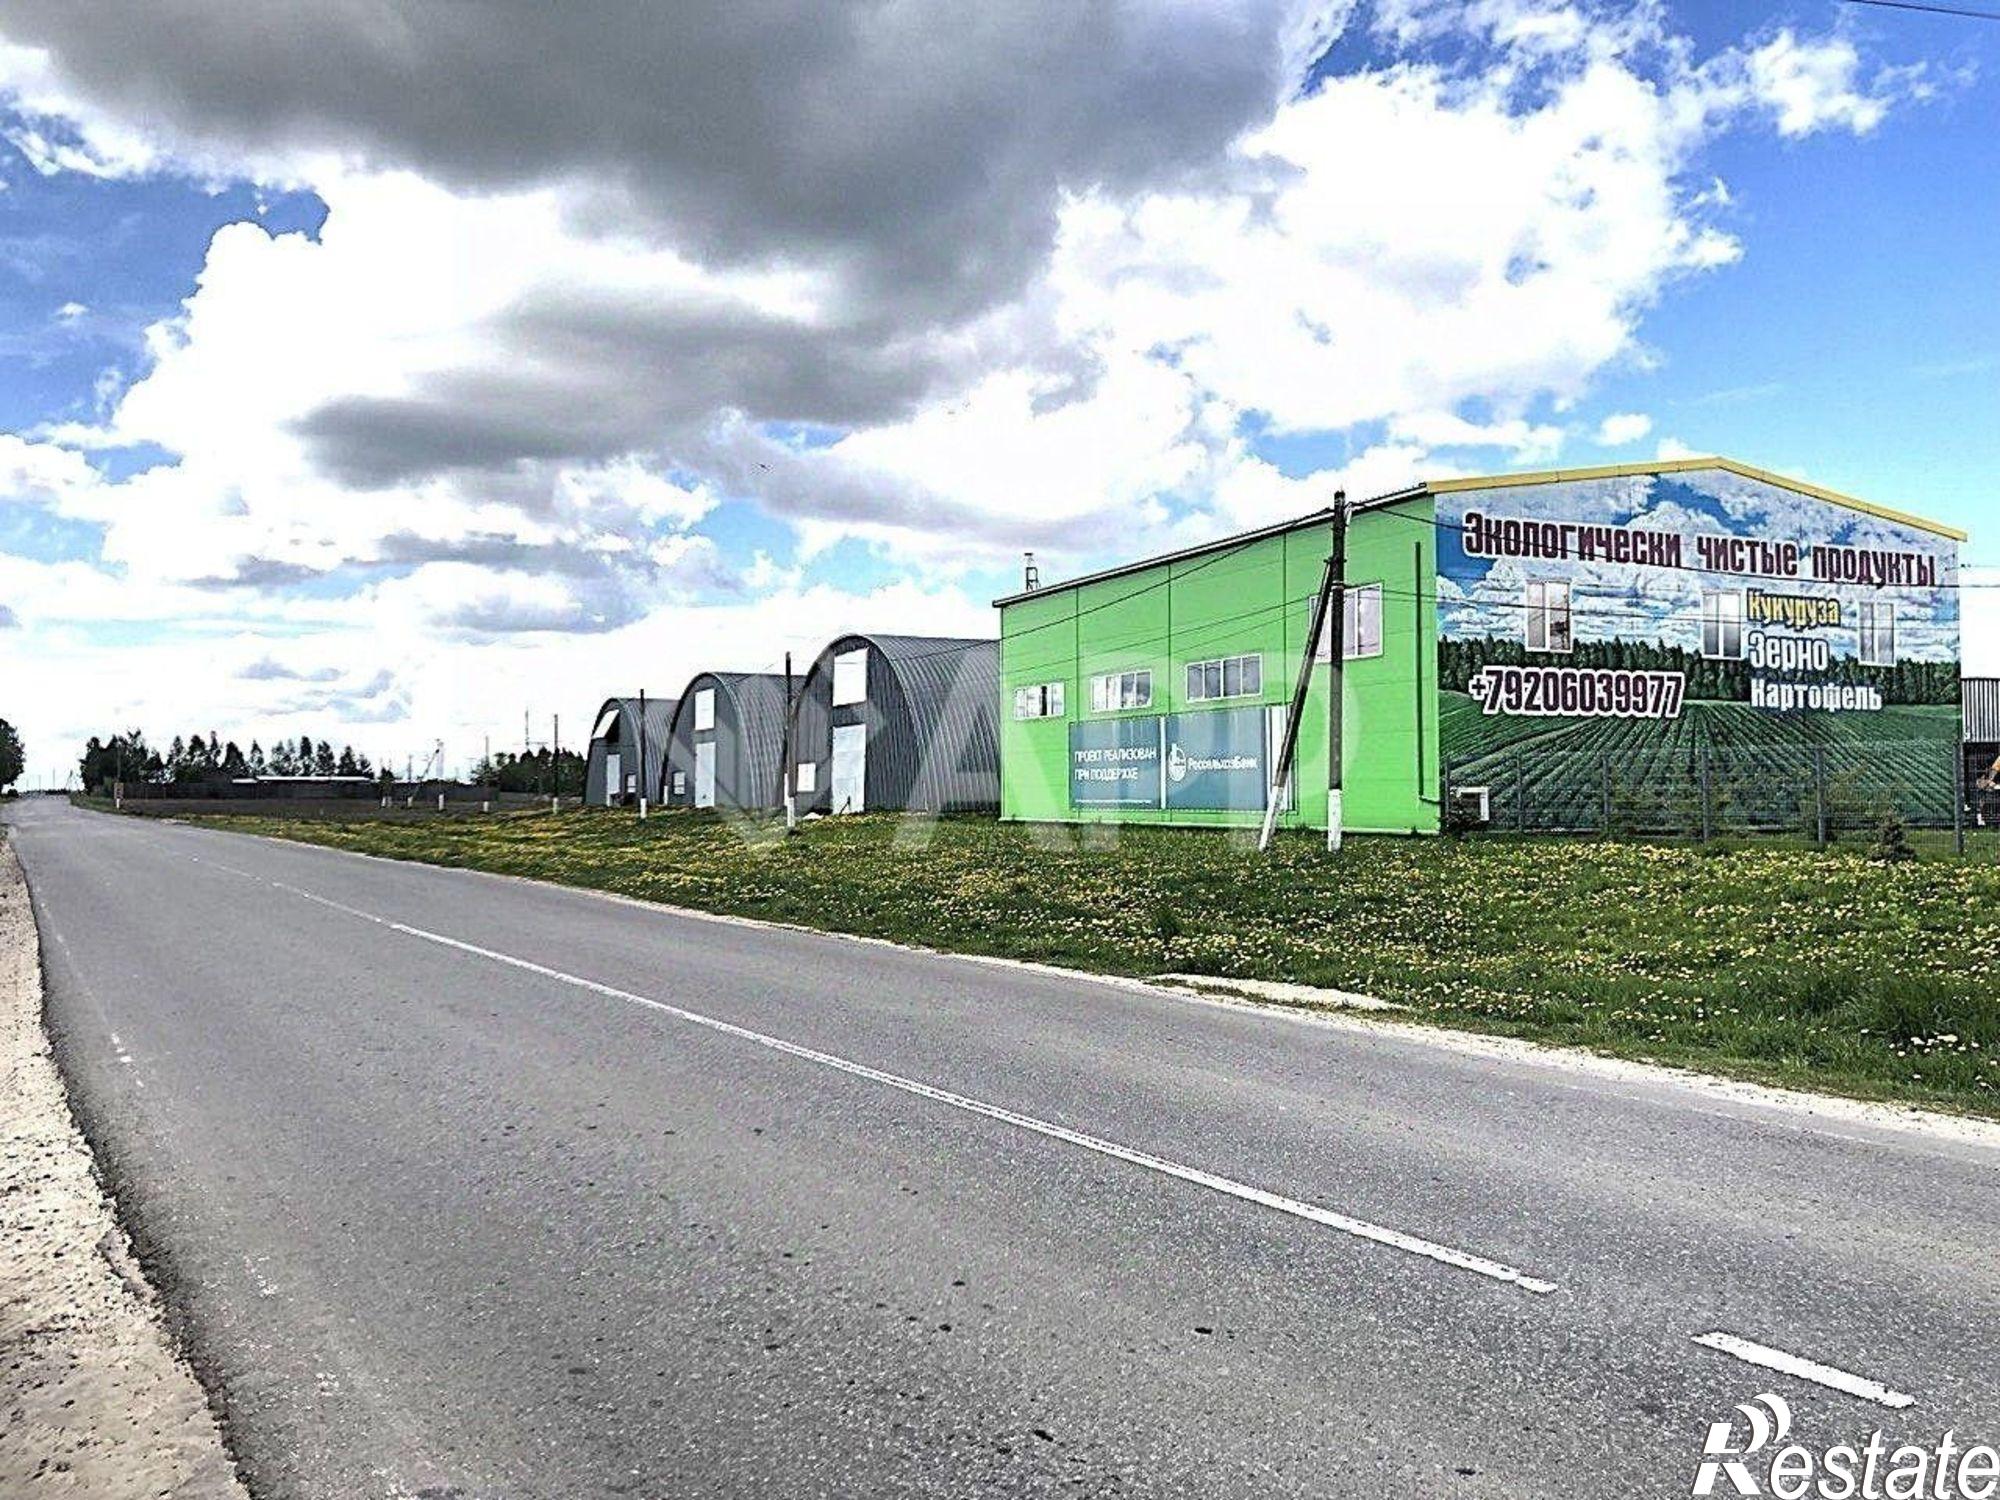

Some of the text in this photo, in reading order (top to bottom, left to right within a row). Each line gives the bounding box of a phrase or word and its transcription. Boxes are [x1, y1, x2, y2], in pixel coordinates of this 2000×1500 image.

[1464, 512, 1938, 590] Экологически чистые продукты
[1748, 589, 1841, 629] Кукуруза
[1749, 634, 1828, 673] Зерно
[1469, 668, 1685, 718] +79206039977
[1751, 678, 1883, 713] Картофель
